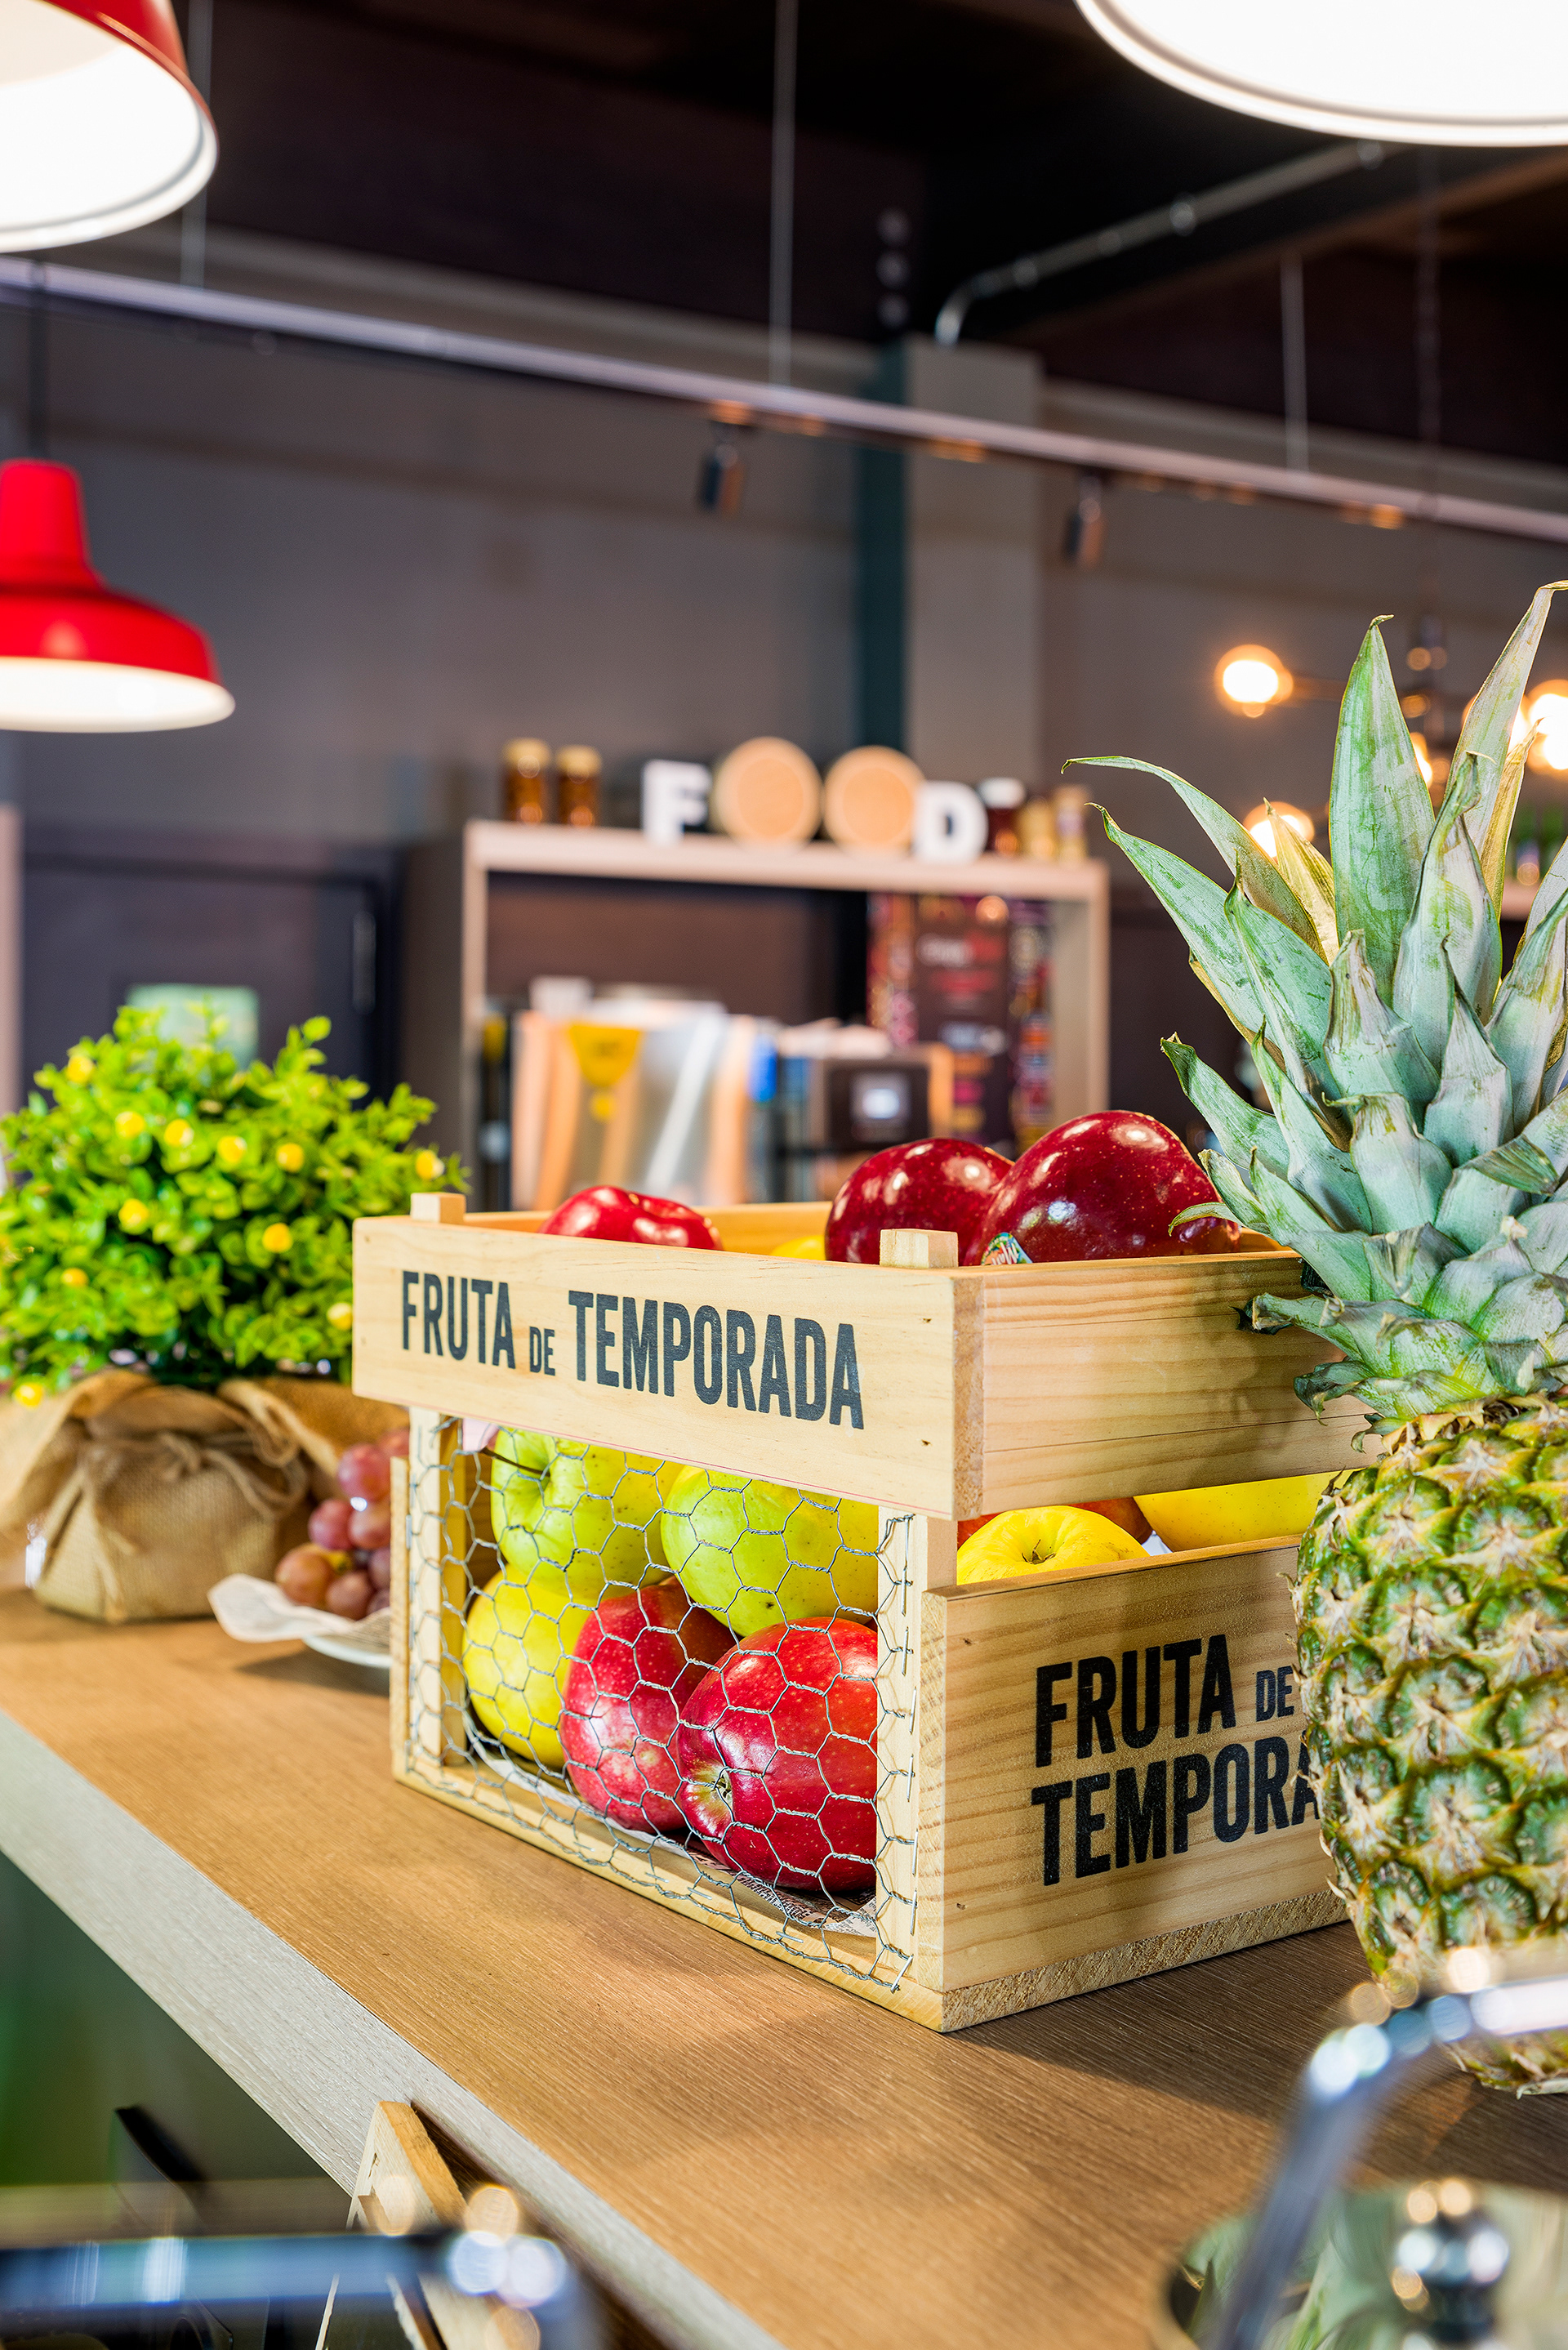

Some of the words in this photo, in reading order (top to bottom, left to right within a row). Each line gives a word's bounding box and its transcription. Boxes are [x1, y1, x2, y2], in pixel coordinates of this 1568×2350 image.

[402, 1270, 516, 1369] FRUTA
[529, 1327, 555, 1376] DE
[568, 1290, 864, 1429] TEMPORADA
[1036, 1634, 1236, 1768] FRUTA
[1255, 1666, 1294, 1722] DE
